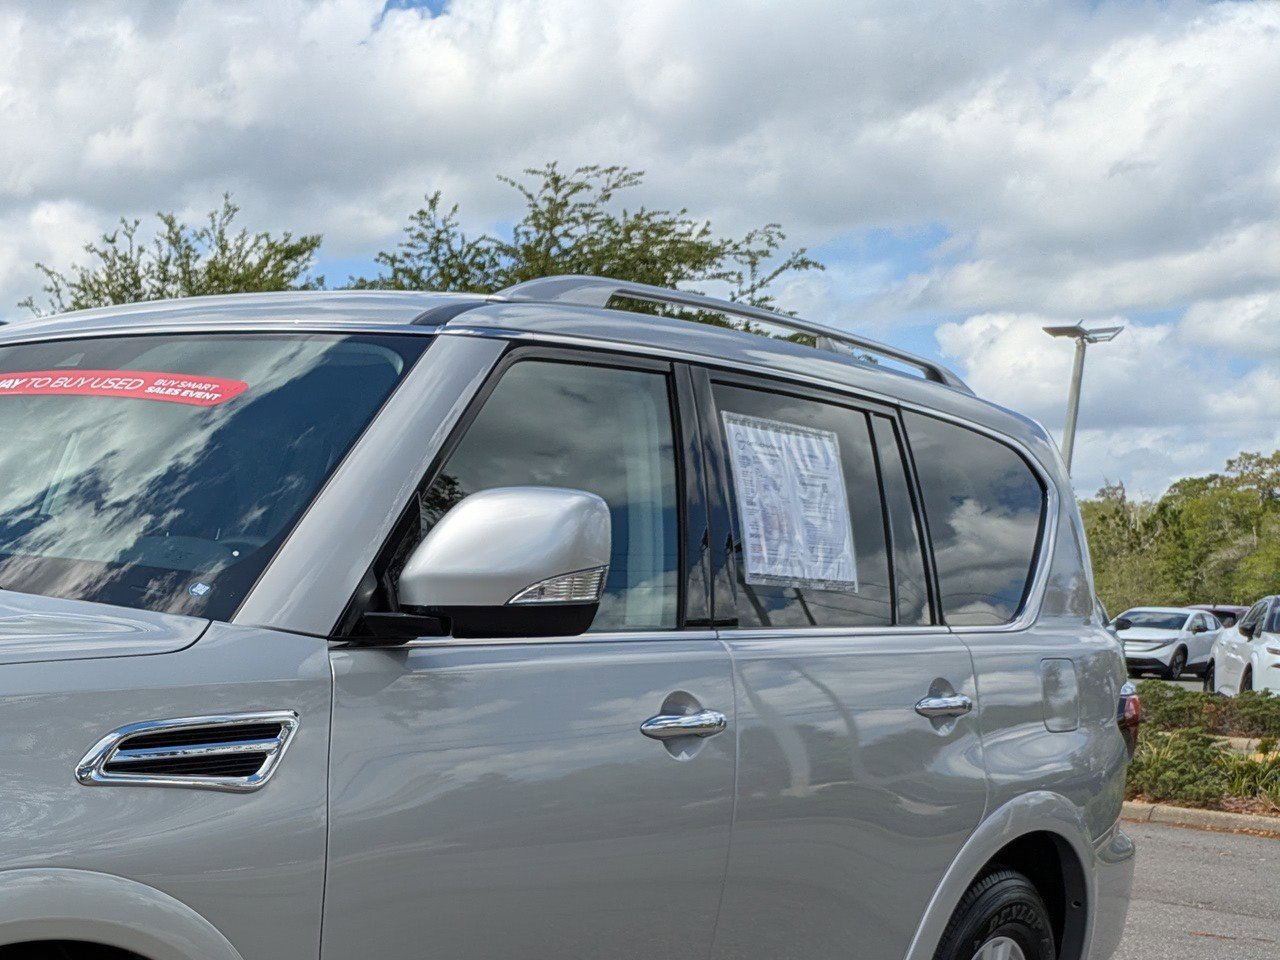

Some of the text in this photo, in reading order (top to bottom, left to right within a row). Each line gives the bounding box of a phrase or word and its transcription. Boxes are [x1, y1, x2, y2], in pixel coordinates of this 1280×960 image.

[27, 377, 52, 388] TO
[50, 376, 92, 389] BUY
[90, 377, 145, 390] USED
[154, 378, 220, 391] BUY SMART
[145, 385, 222, 401] SALES EVENT
